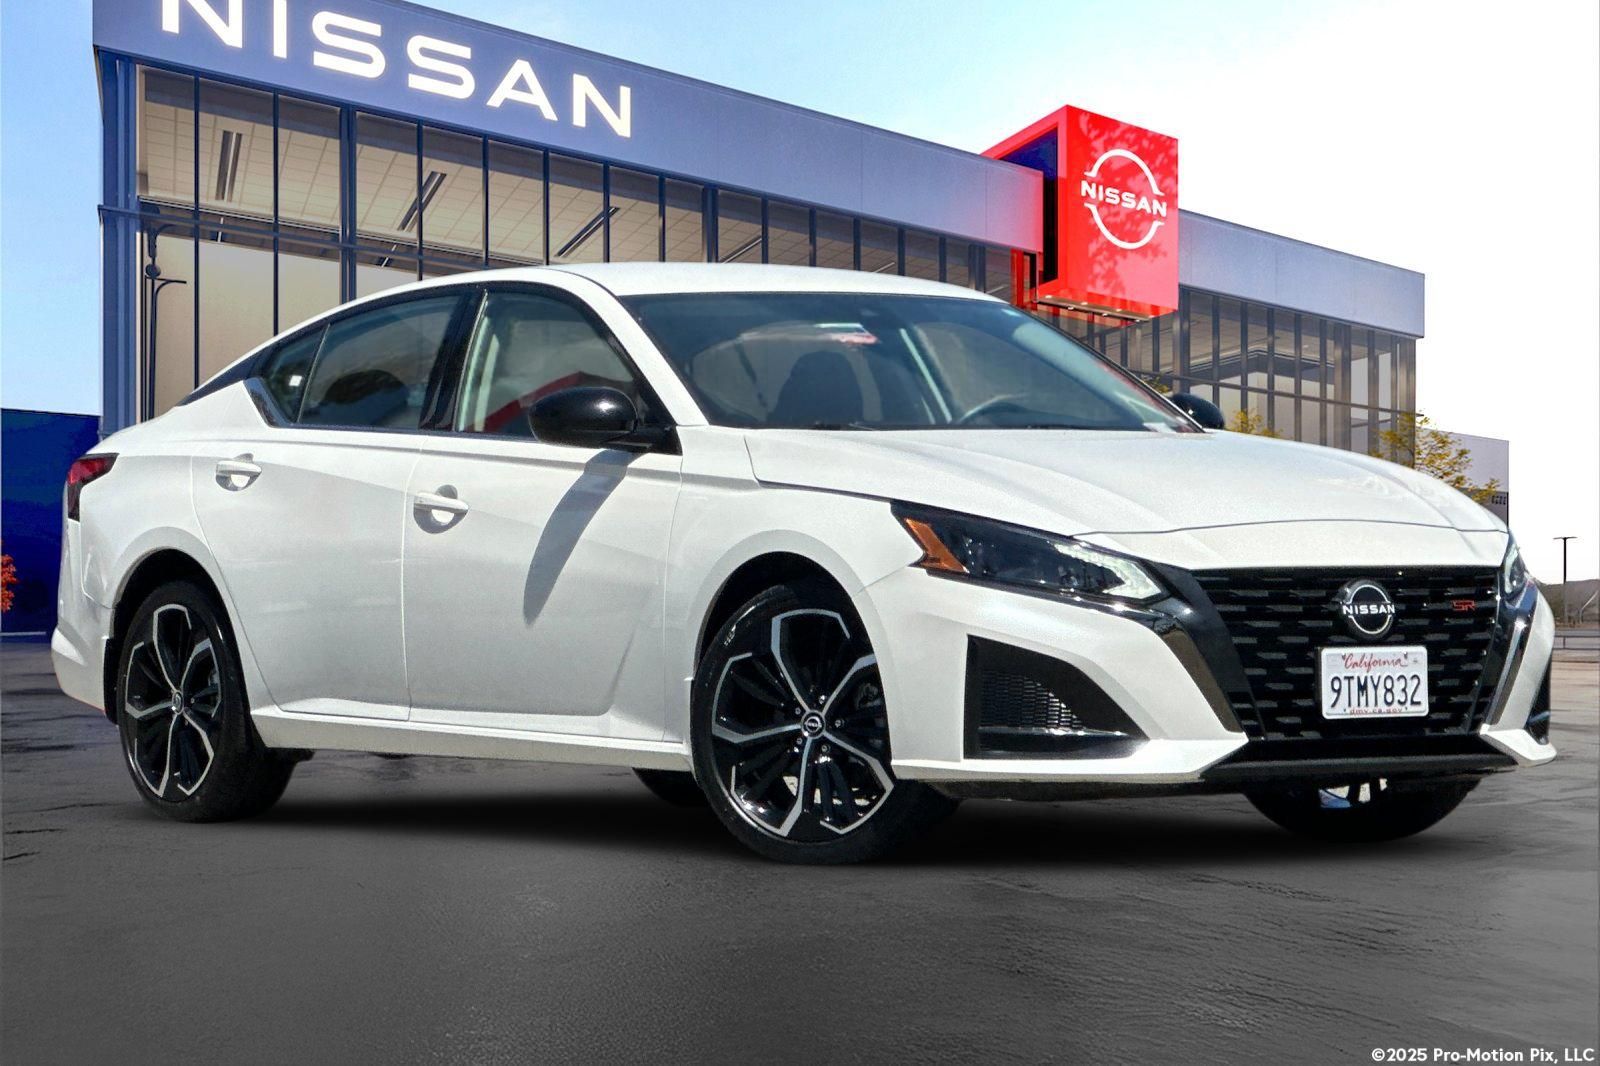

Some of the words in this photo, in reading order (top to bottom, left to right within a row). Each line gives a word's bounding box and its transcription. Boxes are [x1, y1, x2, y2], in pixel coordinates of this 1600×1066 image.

[162, 0, 632, 138] NISSAN
[1080, 179, 1168, 217] NISSAN
[1342, 604, 1395, 615] NISSAN
[1452, 600, 1476, 611] SR
[1344, 653, 1408, 673] California
[1330, 674, 1422, 708] 9TMY832
